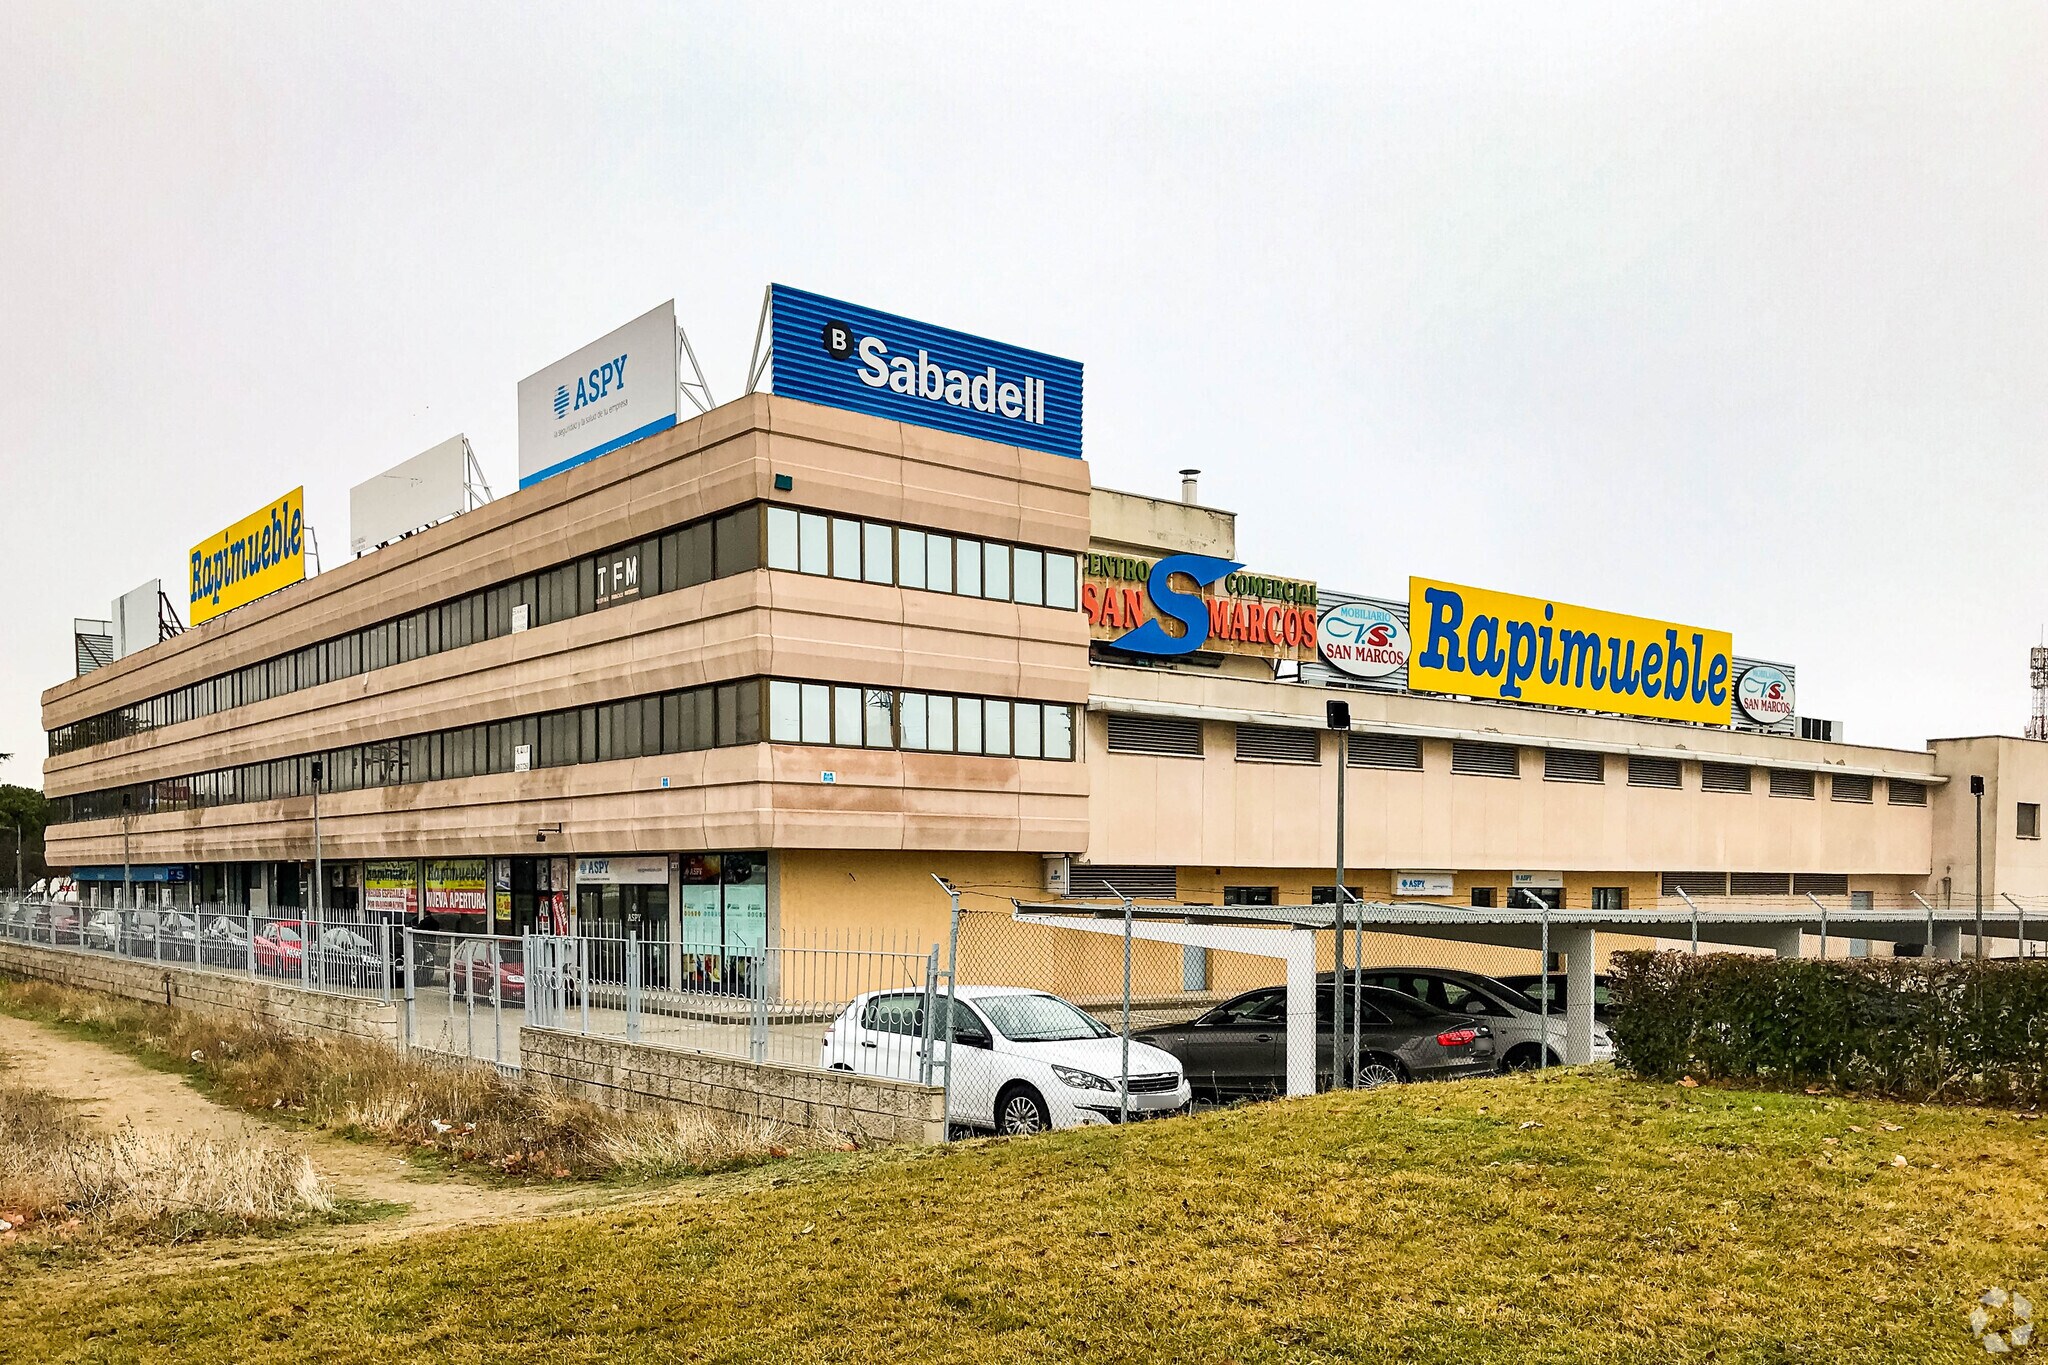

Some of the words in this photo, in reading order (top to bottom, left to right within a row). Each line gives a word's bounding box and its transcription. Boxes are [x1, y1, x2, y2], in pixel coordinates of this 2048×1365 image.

[574, 354, 628, 411] ASPY
[832, 328, 847, 351] B
[857, 336, 1045, 425] Sabadell
[191, 501, 301, 605] Rapimueble
[1225, 573, 1319, 605] COMERCIAL
[1082, 584, 1144, 628] SAN
[1207, 599, 1317, 649] MARCOS
[1341, 607, 1391, 622] MOBILIARIO
[1326, 643, 1351, 660] SAN
[1356, 646, 1404, 665] MARCOS
[1419, 587, 1728, 706] Rapimueble
[1744, 697, 1759, 710] SAN
[1761, 699, 1791, 713] MARCOS
[588, 860, 609, 874] ASPY
[1409, 879, 1425, 888] ASPY
[426, 891, 448, 908] NUEVA
[450, 892, 486, 909] APERTURA
